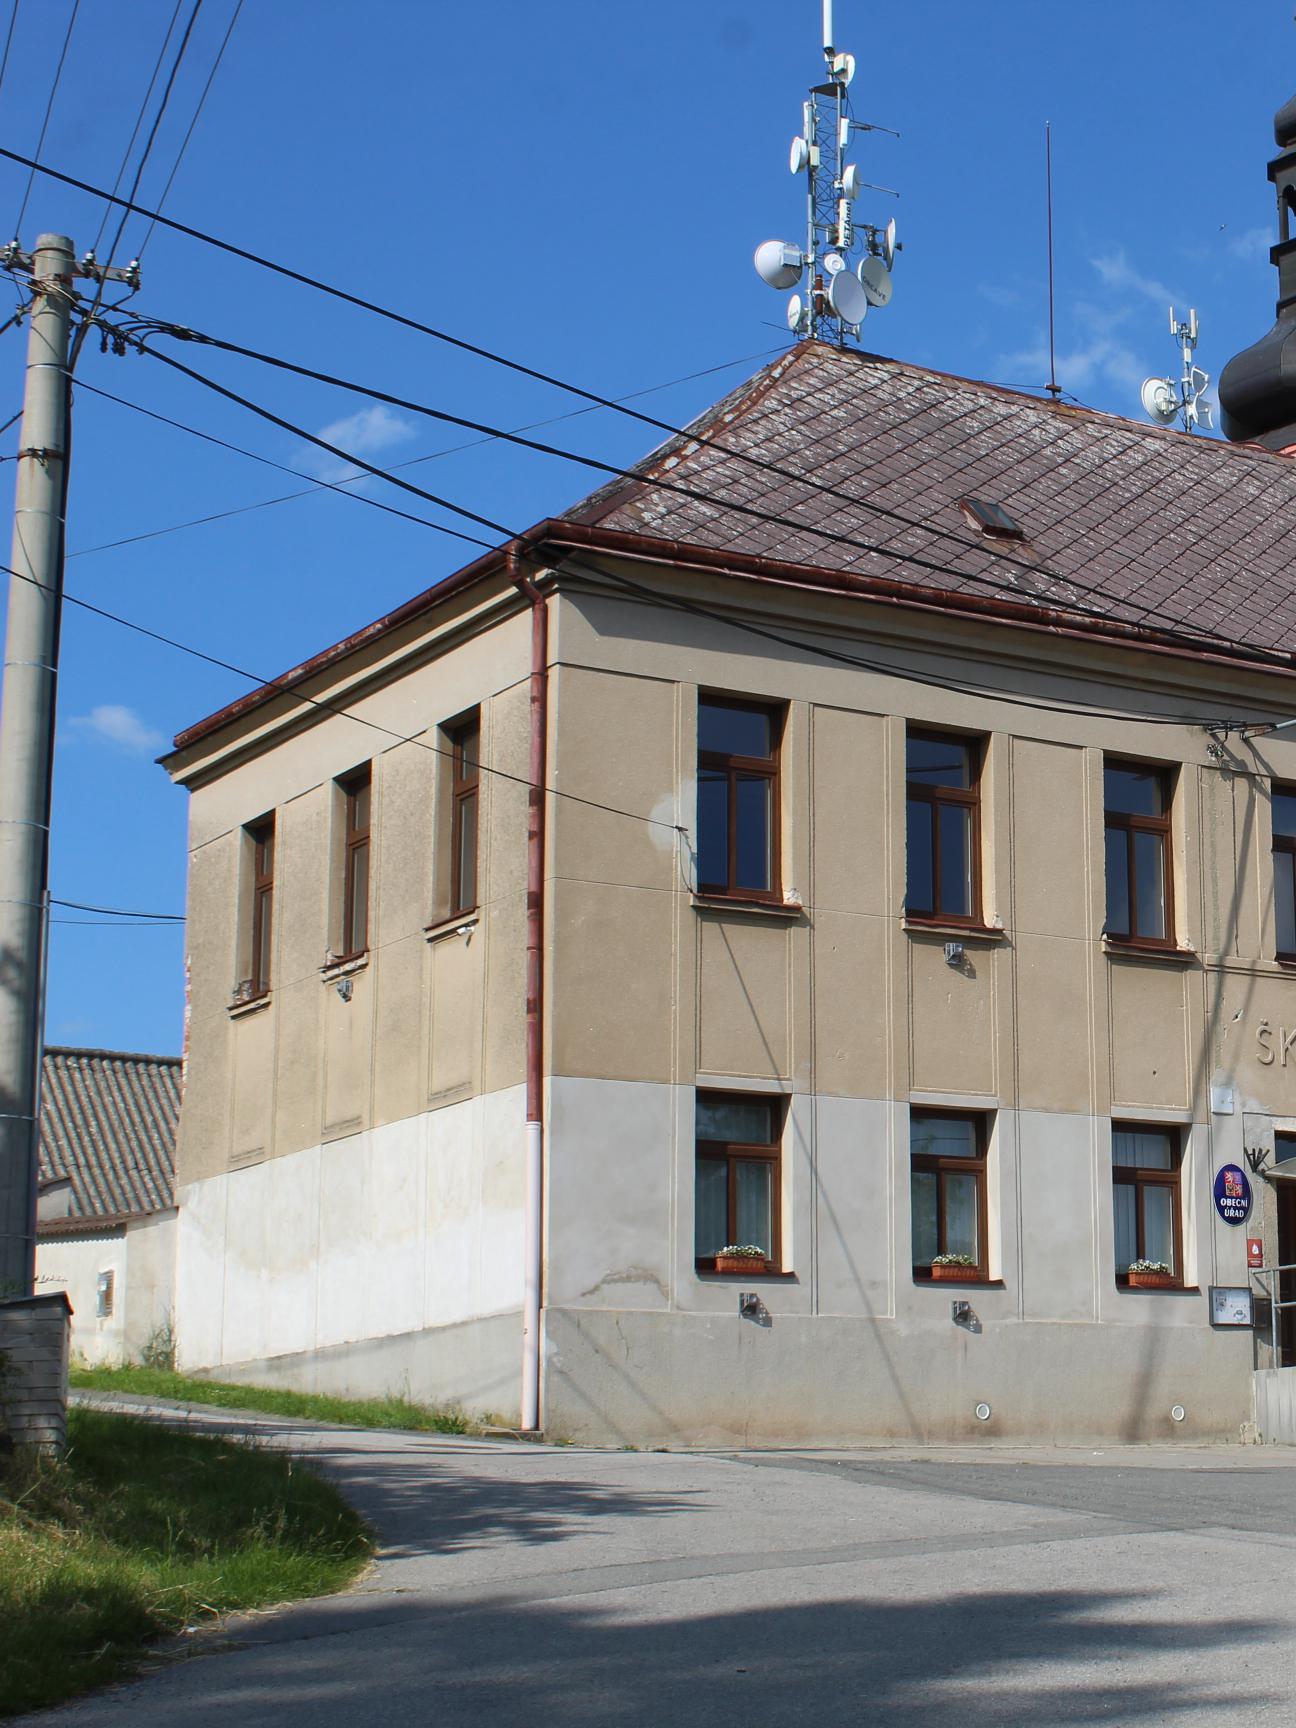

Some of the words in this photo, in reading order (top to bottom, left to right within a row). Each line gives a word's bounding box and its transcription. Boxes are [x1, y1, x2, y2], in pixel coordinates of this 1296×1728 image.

[843, 201, 851, 247] PETAnet
[1220, 1197, 1248, 1208] OBECNÍ
[1224, 1207, 1244, 1218] ÚŘAD
